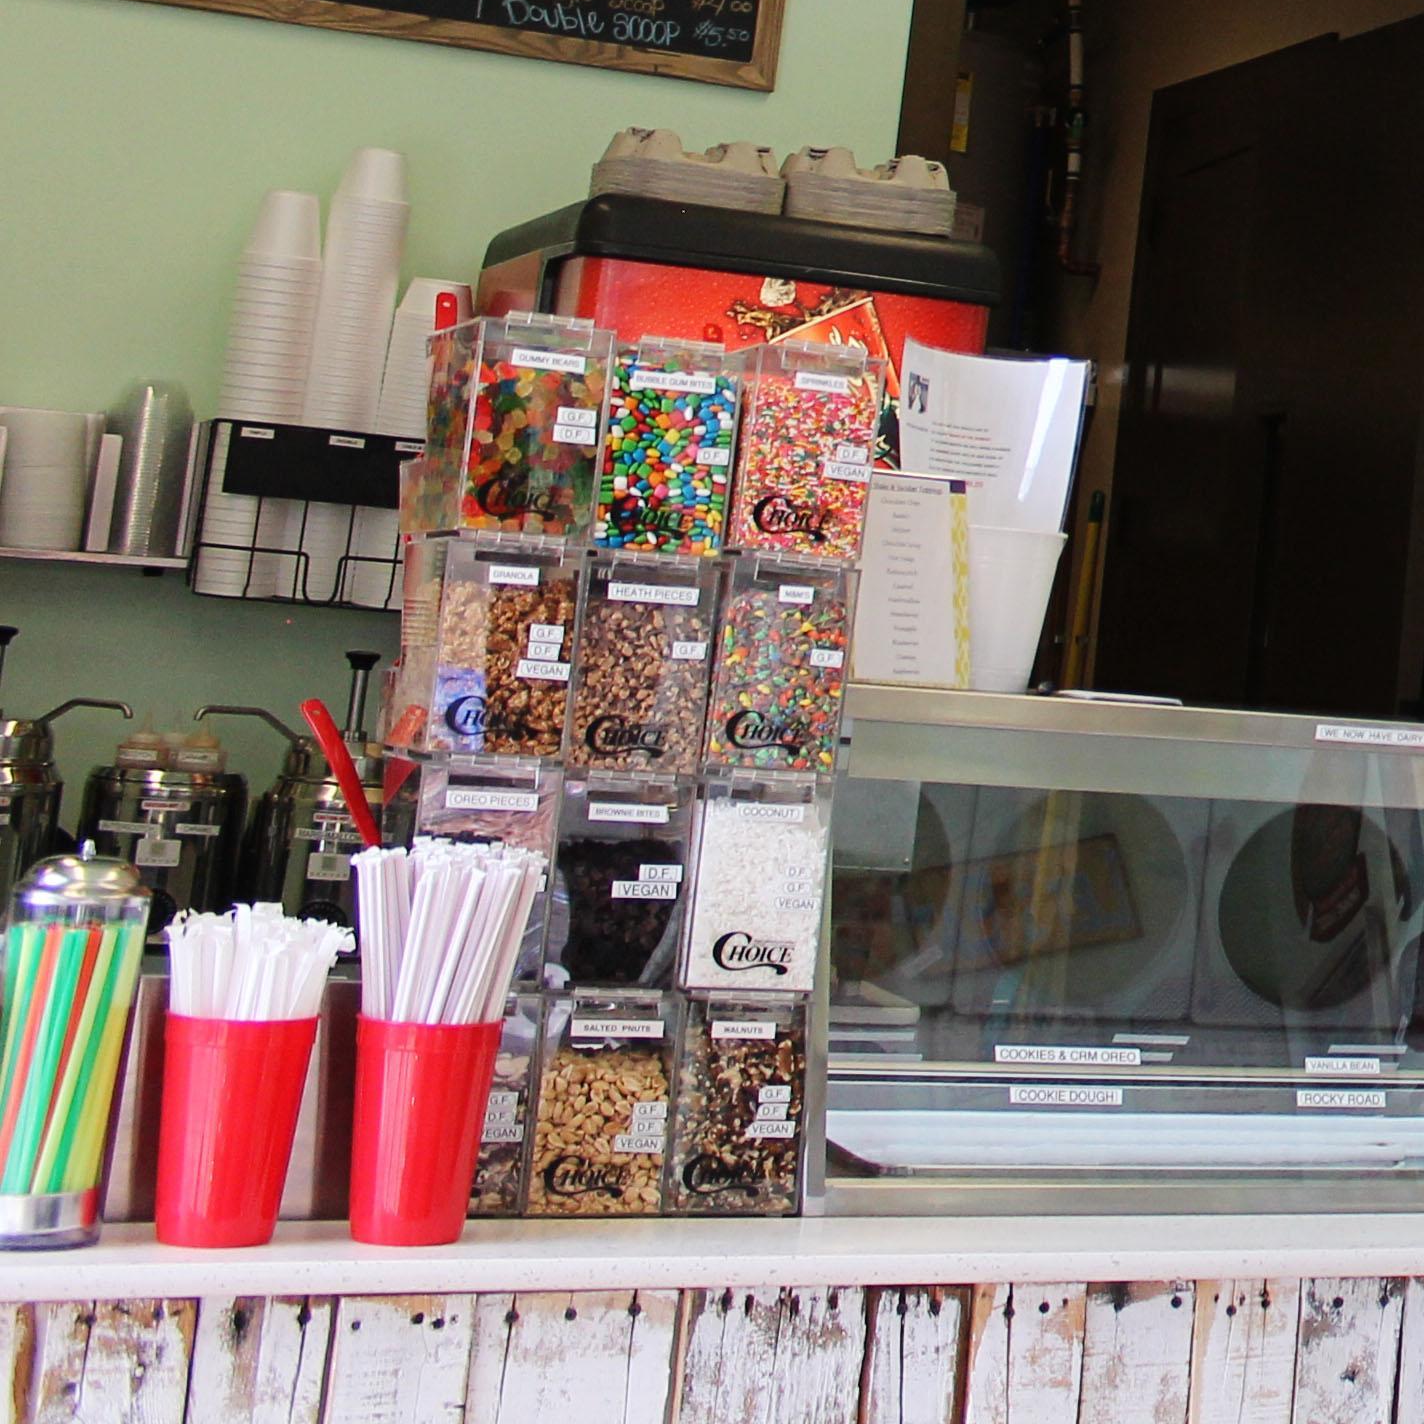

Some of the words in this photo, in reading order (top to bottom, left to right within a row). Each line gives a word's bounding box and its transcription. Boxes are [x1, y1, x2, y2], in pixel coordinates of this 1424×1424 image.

[612, 12, 681, 46] SCOOP
[518, 352, 549, 366] GUMMY
[551, 356, 581, 369] BEARS
[635, 374, 667, 386] BUBBLE
[668, 377, 688, 388] GUM
[689, 379, 714, 390] BITES
[800, 376, 846, 390] SPRINKLES
[830, 464, 866, 478] VEGAN
[493, 569, 535, 581] GRANOLA
[616, 586, 651, 599] HEATH
[654, 589, 694, 601] PIECES
[526, 664, 565, 676] VEGAN
[1322, 729, 1338, 739] WE
[1343, 731, 1364, 740] NOW
[1369, 732, 1392, 742] HAVE
[1397, 734, 1422, 743] DAIRY
[453, 793, 487, 806] OREO
[489, 795, 532, 808] PIECES
[595, 807, 634, 817] BROWNIE
[636, 809, 661, 819] BITES
[742, 806, 796, 818] COCONUT
[622, 883, 671, 897] VEGAN
[778, 899, 815, 911] VEGAN
[712, 931, 795, 975] CHOICE
[583, 1024, 618, 1033] SALTED
[622, 1025, 652, 1034] PNUTS
[723, 1026, 764, 1035] WALNUTS
[999, 1047, 1055, 1061] COOKIES
[1059, 1050, 1067, 1061] &
[1070, 1050, 1098, 1062] CRM
[1100, 1051, 1137, 1063] OREO
[1311, 1061, 1347, 1070] VANILLA
[1349, 1061, 1374, 1071] BEAN
[1019, 1089, 1067, 1102] COOKIE
[1069, 1090, 1115, 1103] DOUGH
[1304, 1093, 1345, 1104] ROCKY
[1347, 1094, 1381, 1105] ROAD
[752, 1124, 790, 1136] VEGAN
[620, 1138, 658, 1150] VEGAN
